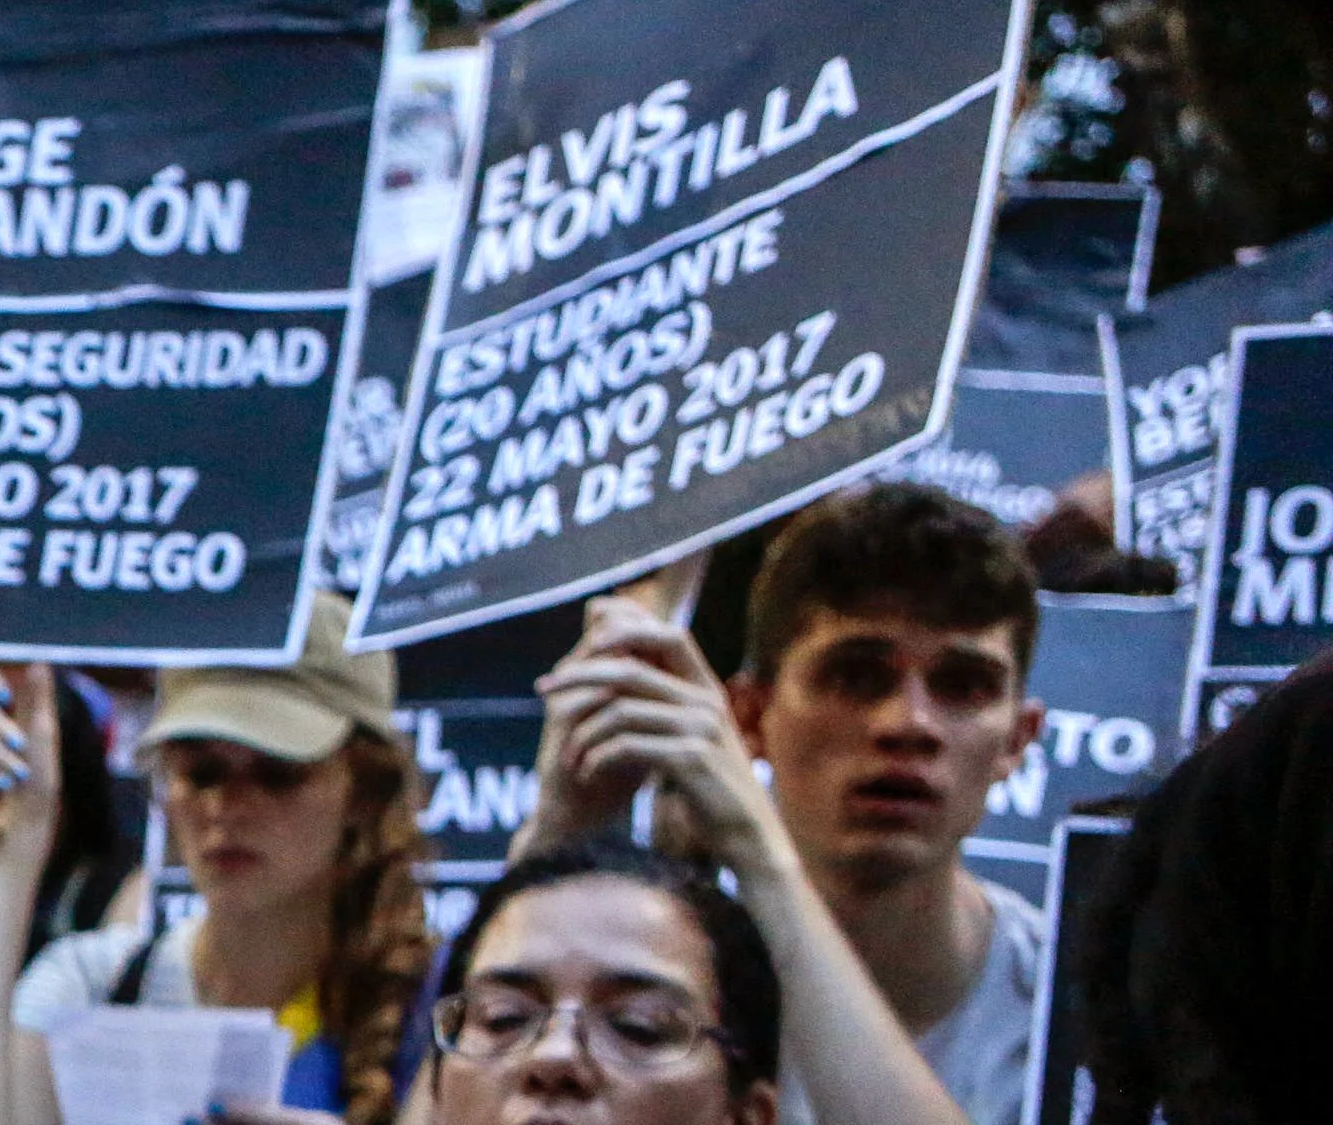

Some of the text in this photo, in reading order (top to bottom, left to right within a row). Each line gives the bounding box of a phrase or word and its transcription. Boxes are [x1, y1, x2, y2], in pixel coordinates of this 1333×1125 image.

[461, 55, 859, 293] MONTILLA
[478, 80, 693, 226] ELVIS
[419, 384, 517, 467] (20
[517, 301, 714, 426] AÑOS)
[434, 208, 785, 400] ESTUDIANTE
[44, 465, 198, 522] 2017
[384, 481, 562, 586] ARMA
[572, 444, 663, 528] DE
[668, 350, 887, 492] FUEGO
[402, 454, 482, 523] 22
[487, 382, 669, 497] MAYO
[675, 308, 837, 425] 2017
[40, 530, 247, 592] FUEGO
[1231, 484, 1333, 566] JO
